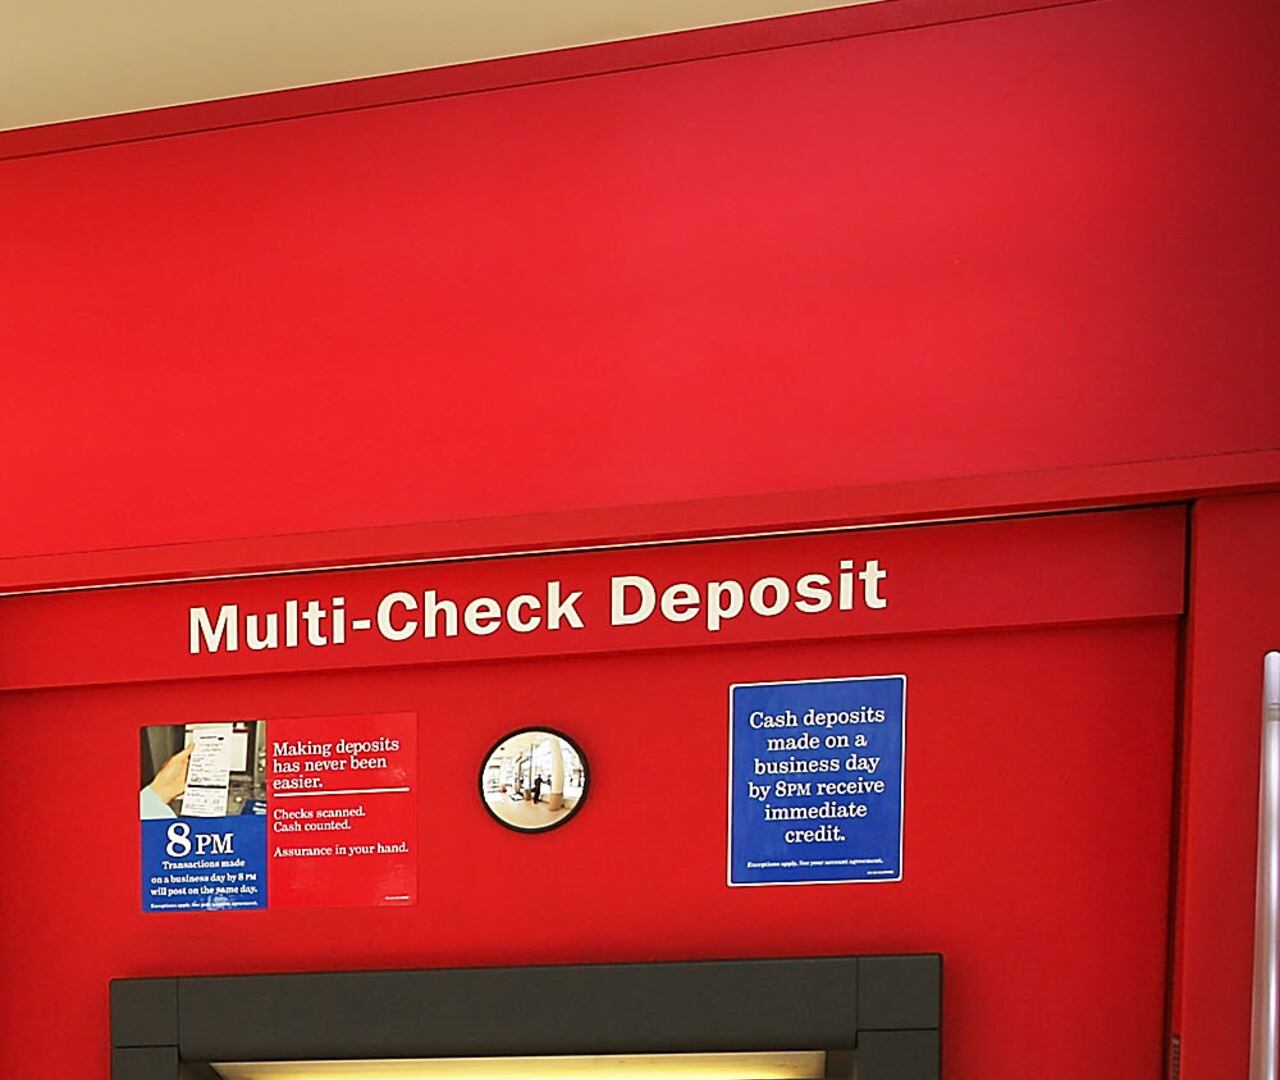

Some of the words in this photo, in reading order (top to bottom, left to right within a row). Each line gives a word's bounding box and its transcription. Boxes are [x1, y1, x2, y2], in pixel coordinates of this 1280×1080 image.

[189, 582, 583, 654] Multi-Check
[610, 561, 886, 631] Deposit
[750, 711, 798, 728] Cash
[804, 706, 885, 728] deposits
[273, 741, 331, 758] Making
[336, 738, 399, 754] deposits
[767, 733, 820, 751] made
[825, 736, 849, 747] on
[855, 735, 867, 747] a
[273, 760, 300, 773] has
[305, 758, 346, 770] never
[350, 756, 387, 769] been
[754, 757, 840, 775] business
[845, 754, 880, 773] day
[273, 776, 323, 789] easier.
[748, 782, 771, 801] by
[775, 781, 811, 796] 8PM
[817, 778, 885, 795] receive
[273, 809, 313, 820] Checks
[317, 807, 365, 818] scanned.
[765, 802, 867, 821] immediate
[273, 822, 302, 832] Cash
[305, 820, 351, 830] counted.
[785, 825, 845, 843] credit.
[166, 822, 191, 857] 8
[196, 834, 234, 853] PM
[273, 846, 332, 857] Assurance
[335, 845, 346, 854] in
[349, 845, 375, 856] your
[377, 841, 408, 852] hand.
[162, 860, 220, 870] Transactions
[221, 859, 245, 867] made
[171, 875, 208, 883] business
[210, 874, 225, 884] day
[227, 873, 236, 883] by
[238, 873, 244, 881] 8
[151, 887, 167, 896] will
[168, 888, 186, 897] post
[200, 886, 214, 894] the
[216, 887, 238, 895] same
[240, 885, 257, 894] day.
